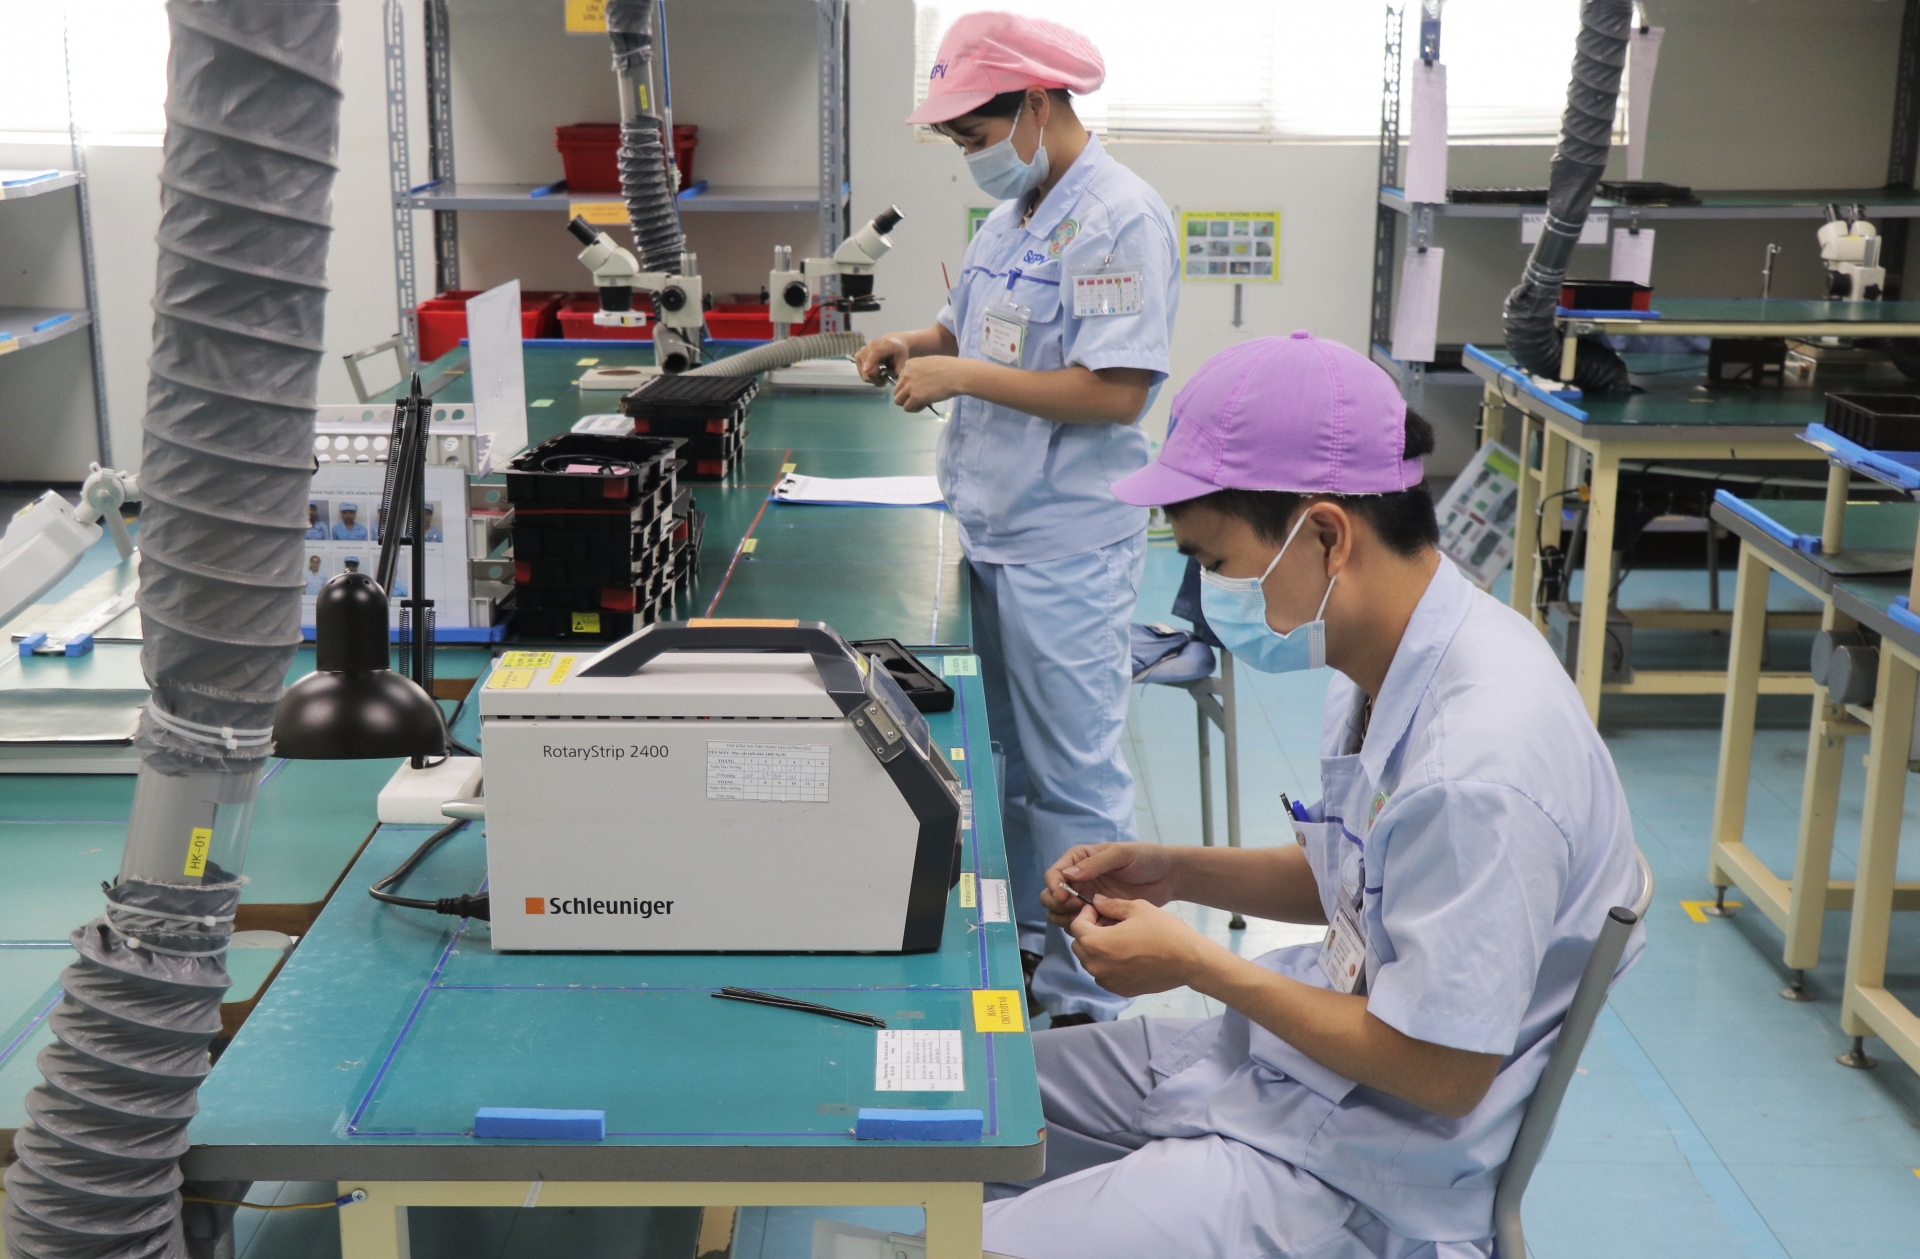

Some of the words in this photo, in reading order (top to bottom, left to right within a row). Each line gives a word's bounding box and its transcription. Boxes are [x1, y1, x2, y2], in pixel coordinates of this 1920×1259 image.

[543, 745, 625, 761] RotaryStrip
[630, 745, 669, 758] 2400
[190, 836, 207, 870] HK-01
[549, 897, 675, 919] Schleuniger
